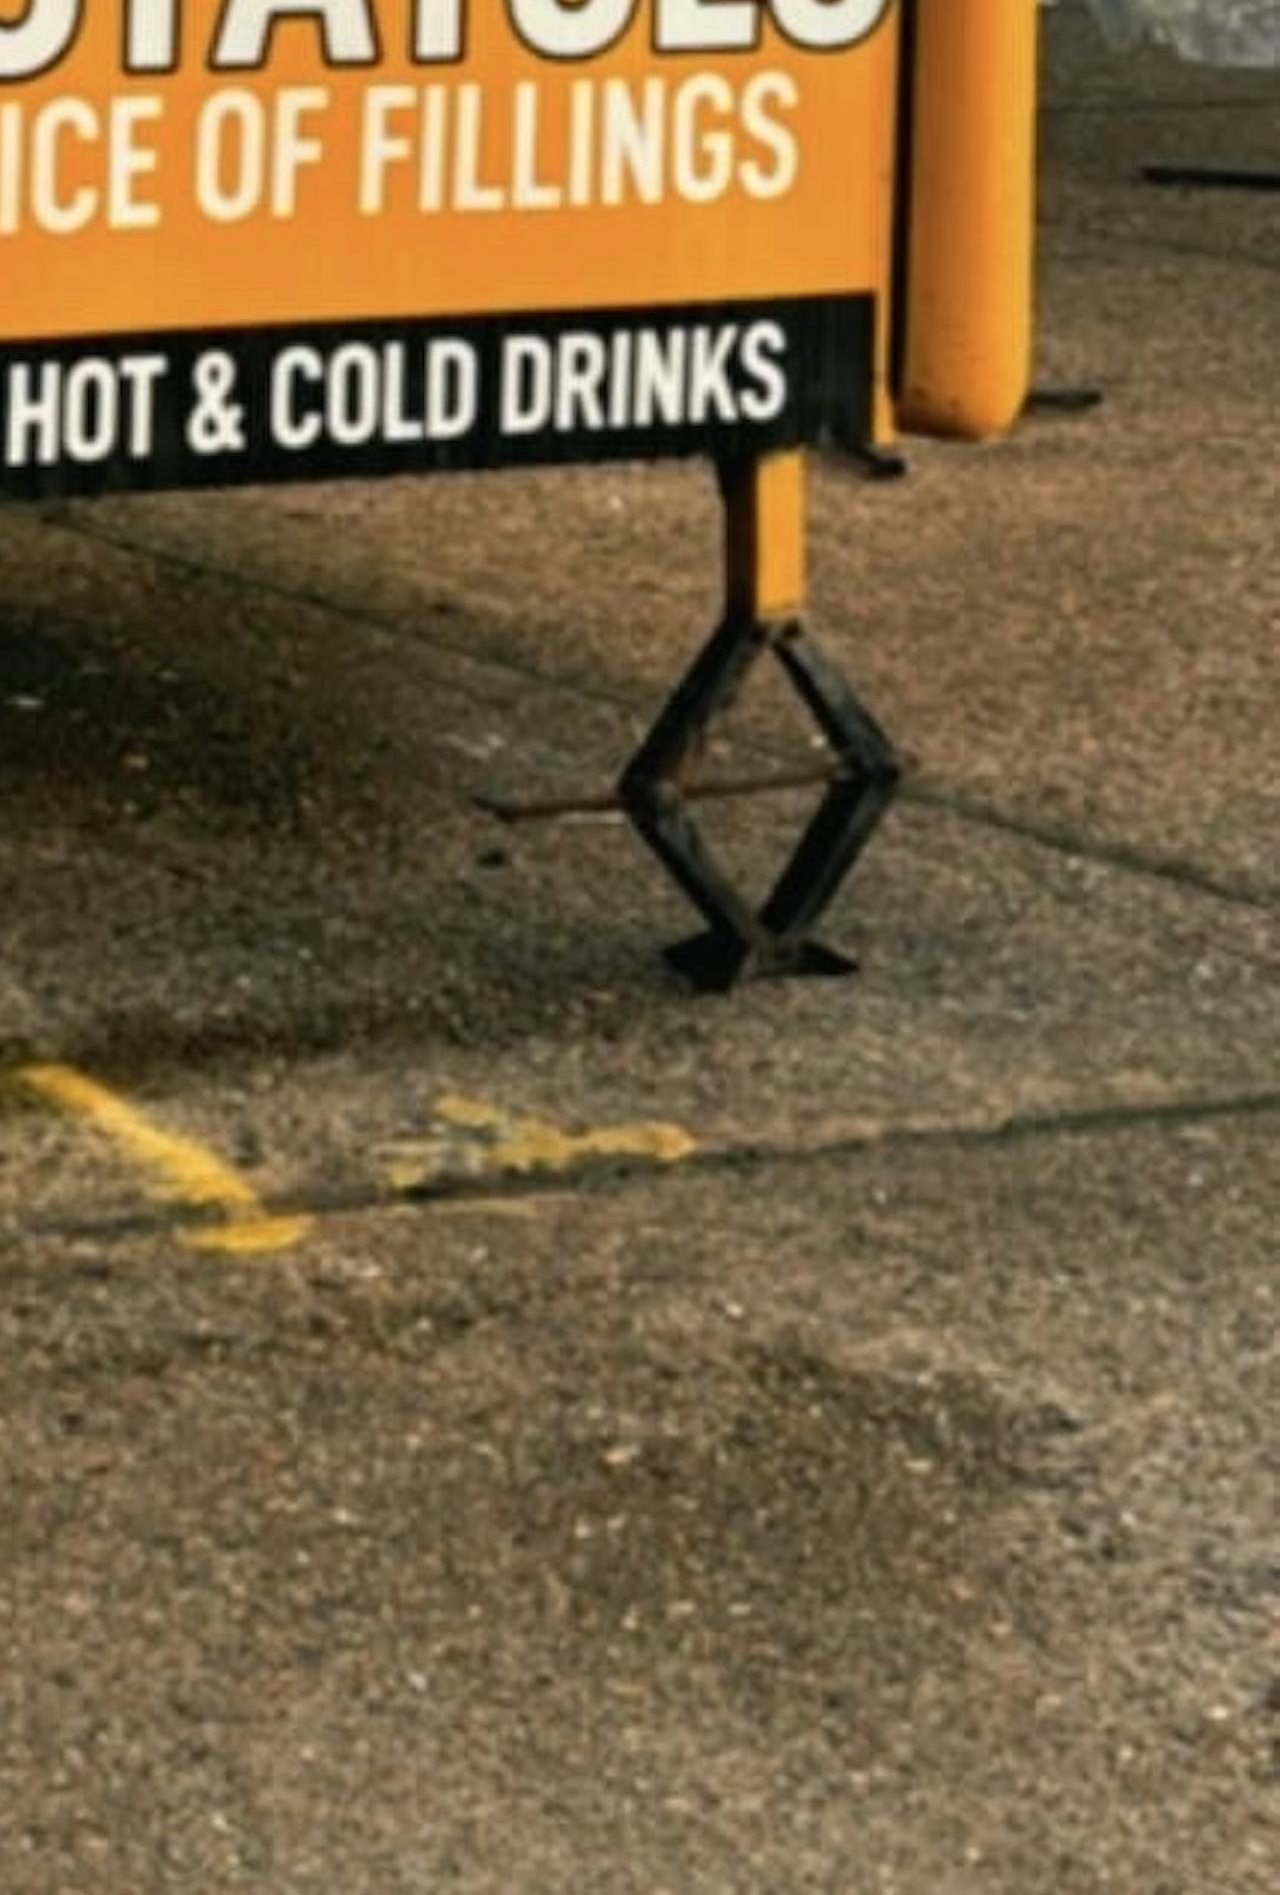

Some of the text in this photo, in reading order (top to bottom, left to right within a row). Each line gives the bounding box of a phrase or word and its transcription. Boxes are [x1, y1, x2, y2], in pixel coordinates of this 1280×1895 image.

[196, 86, 330, 223] OF
[359, 71, 799, 216] FILLINGS
[5, 320, 788, 467] HOT & COLD DRINKS
